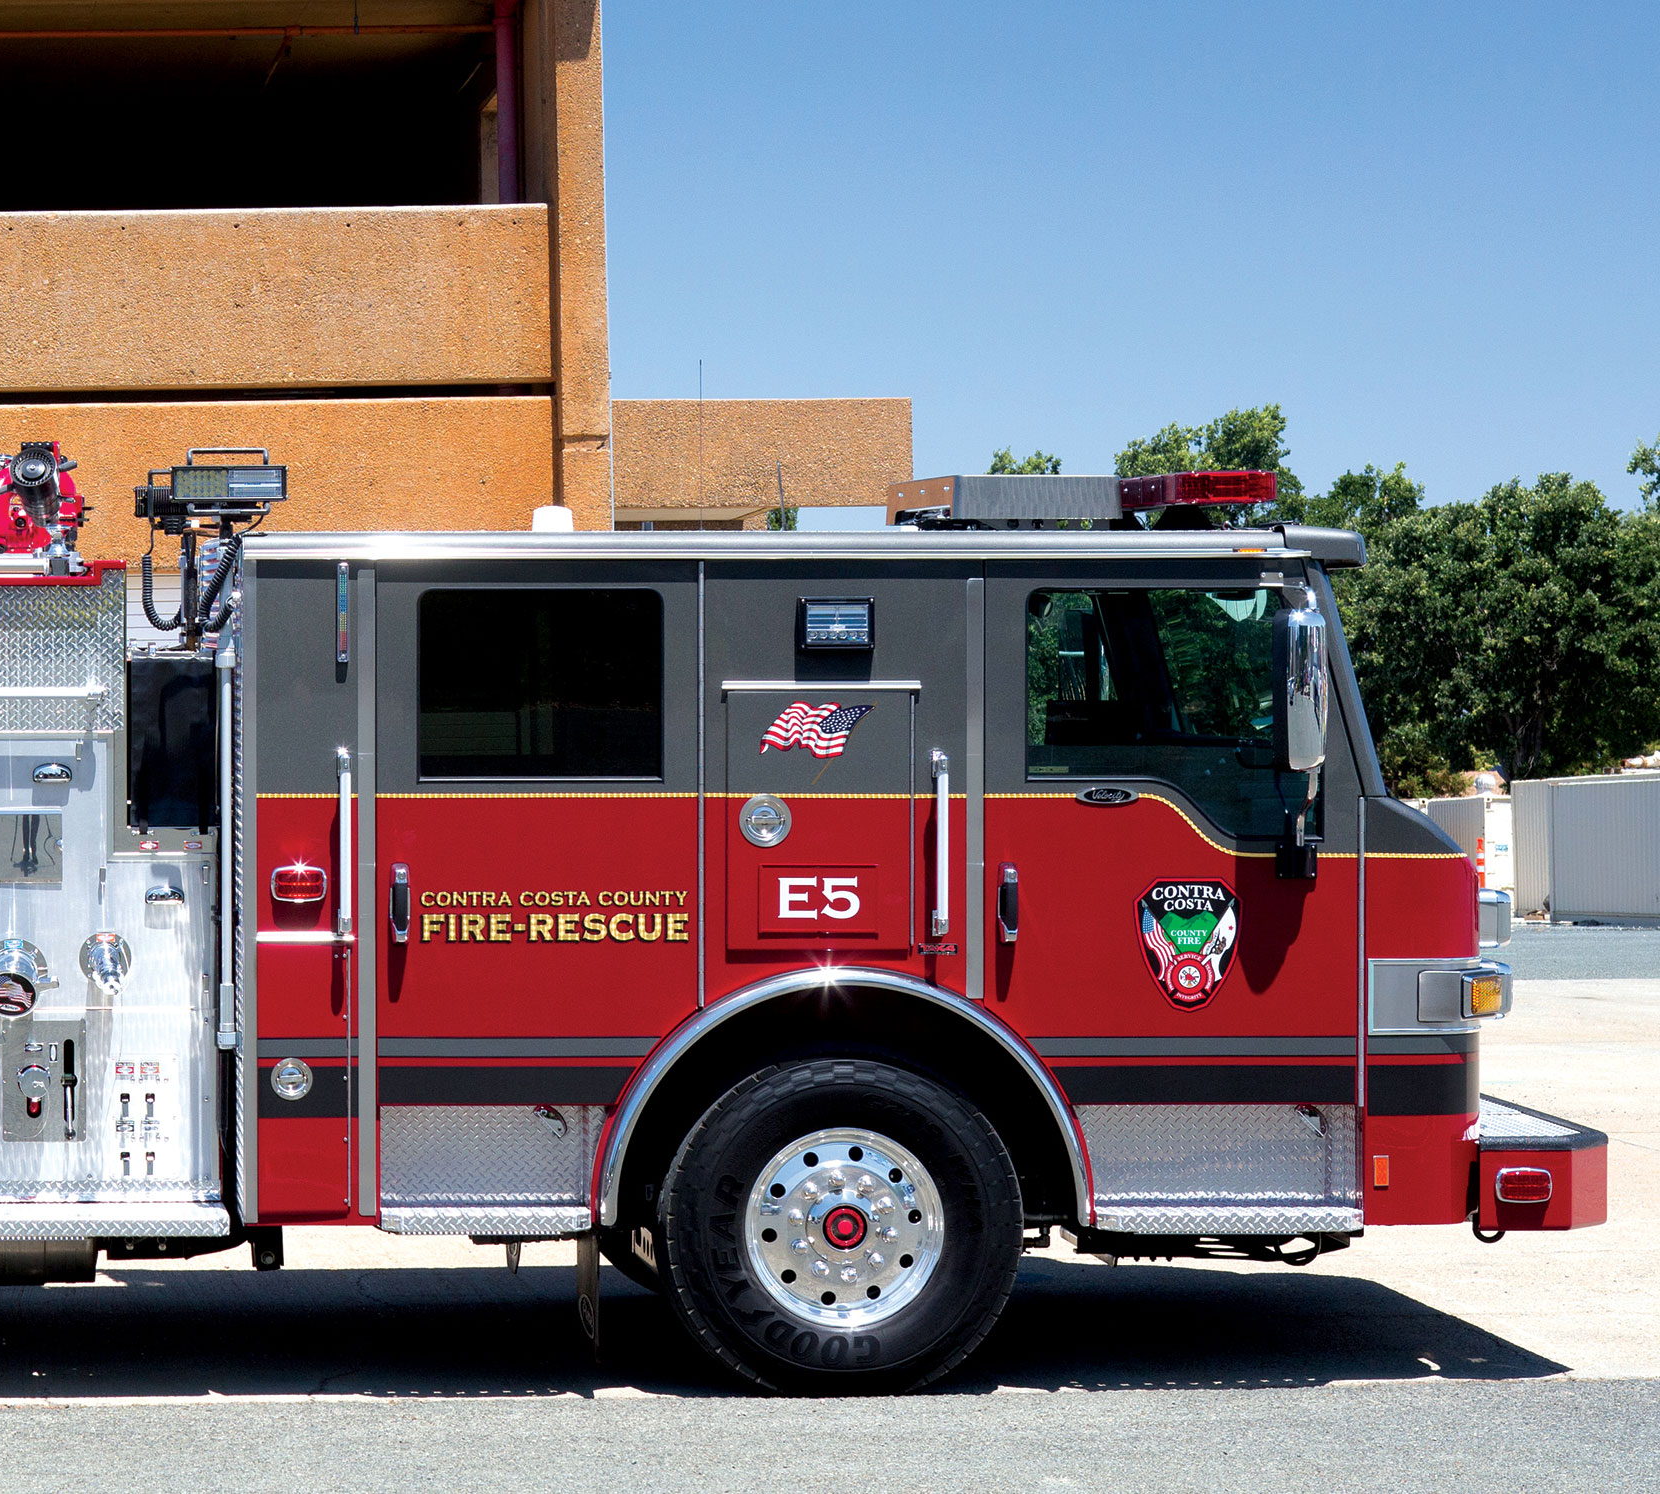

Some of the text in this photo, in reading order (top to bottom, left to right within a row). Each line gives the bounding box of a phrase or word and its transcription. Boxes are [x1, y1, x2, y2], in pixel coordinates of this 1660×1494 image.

[1091, 789, 1126, 801] Velocity
[420, 890, 688, 907] CONTRA COSTA COUNTY
[777, 875, 861, 920] E5
[1151, 884, 1226, 901] CONTRA
[1163, 898, 1214, 912] COSTA
[420, 911, 689, 943] FIRE-RESCUE
[1170, 929, 1208, 937] COUNTY
[1177, 936, 1202, 945] FIRE
